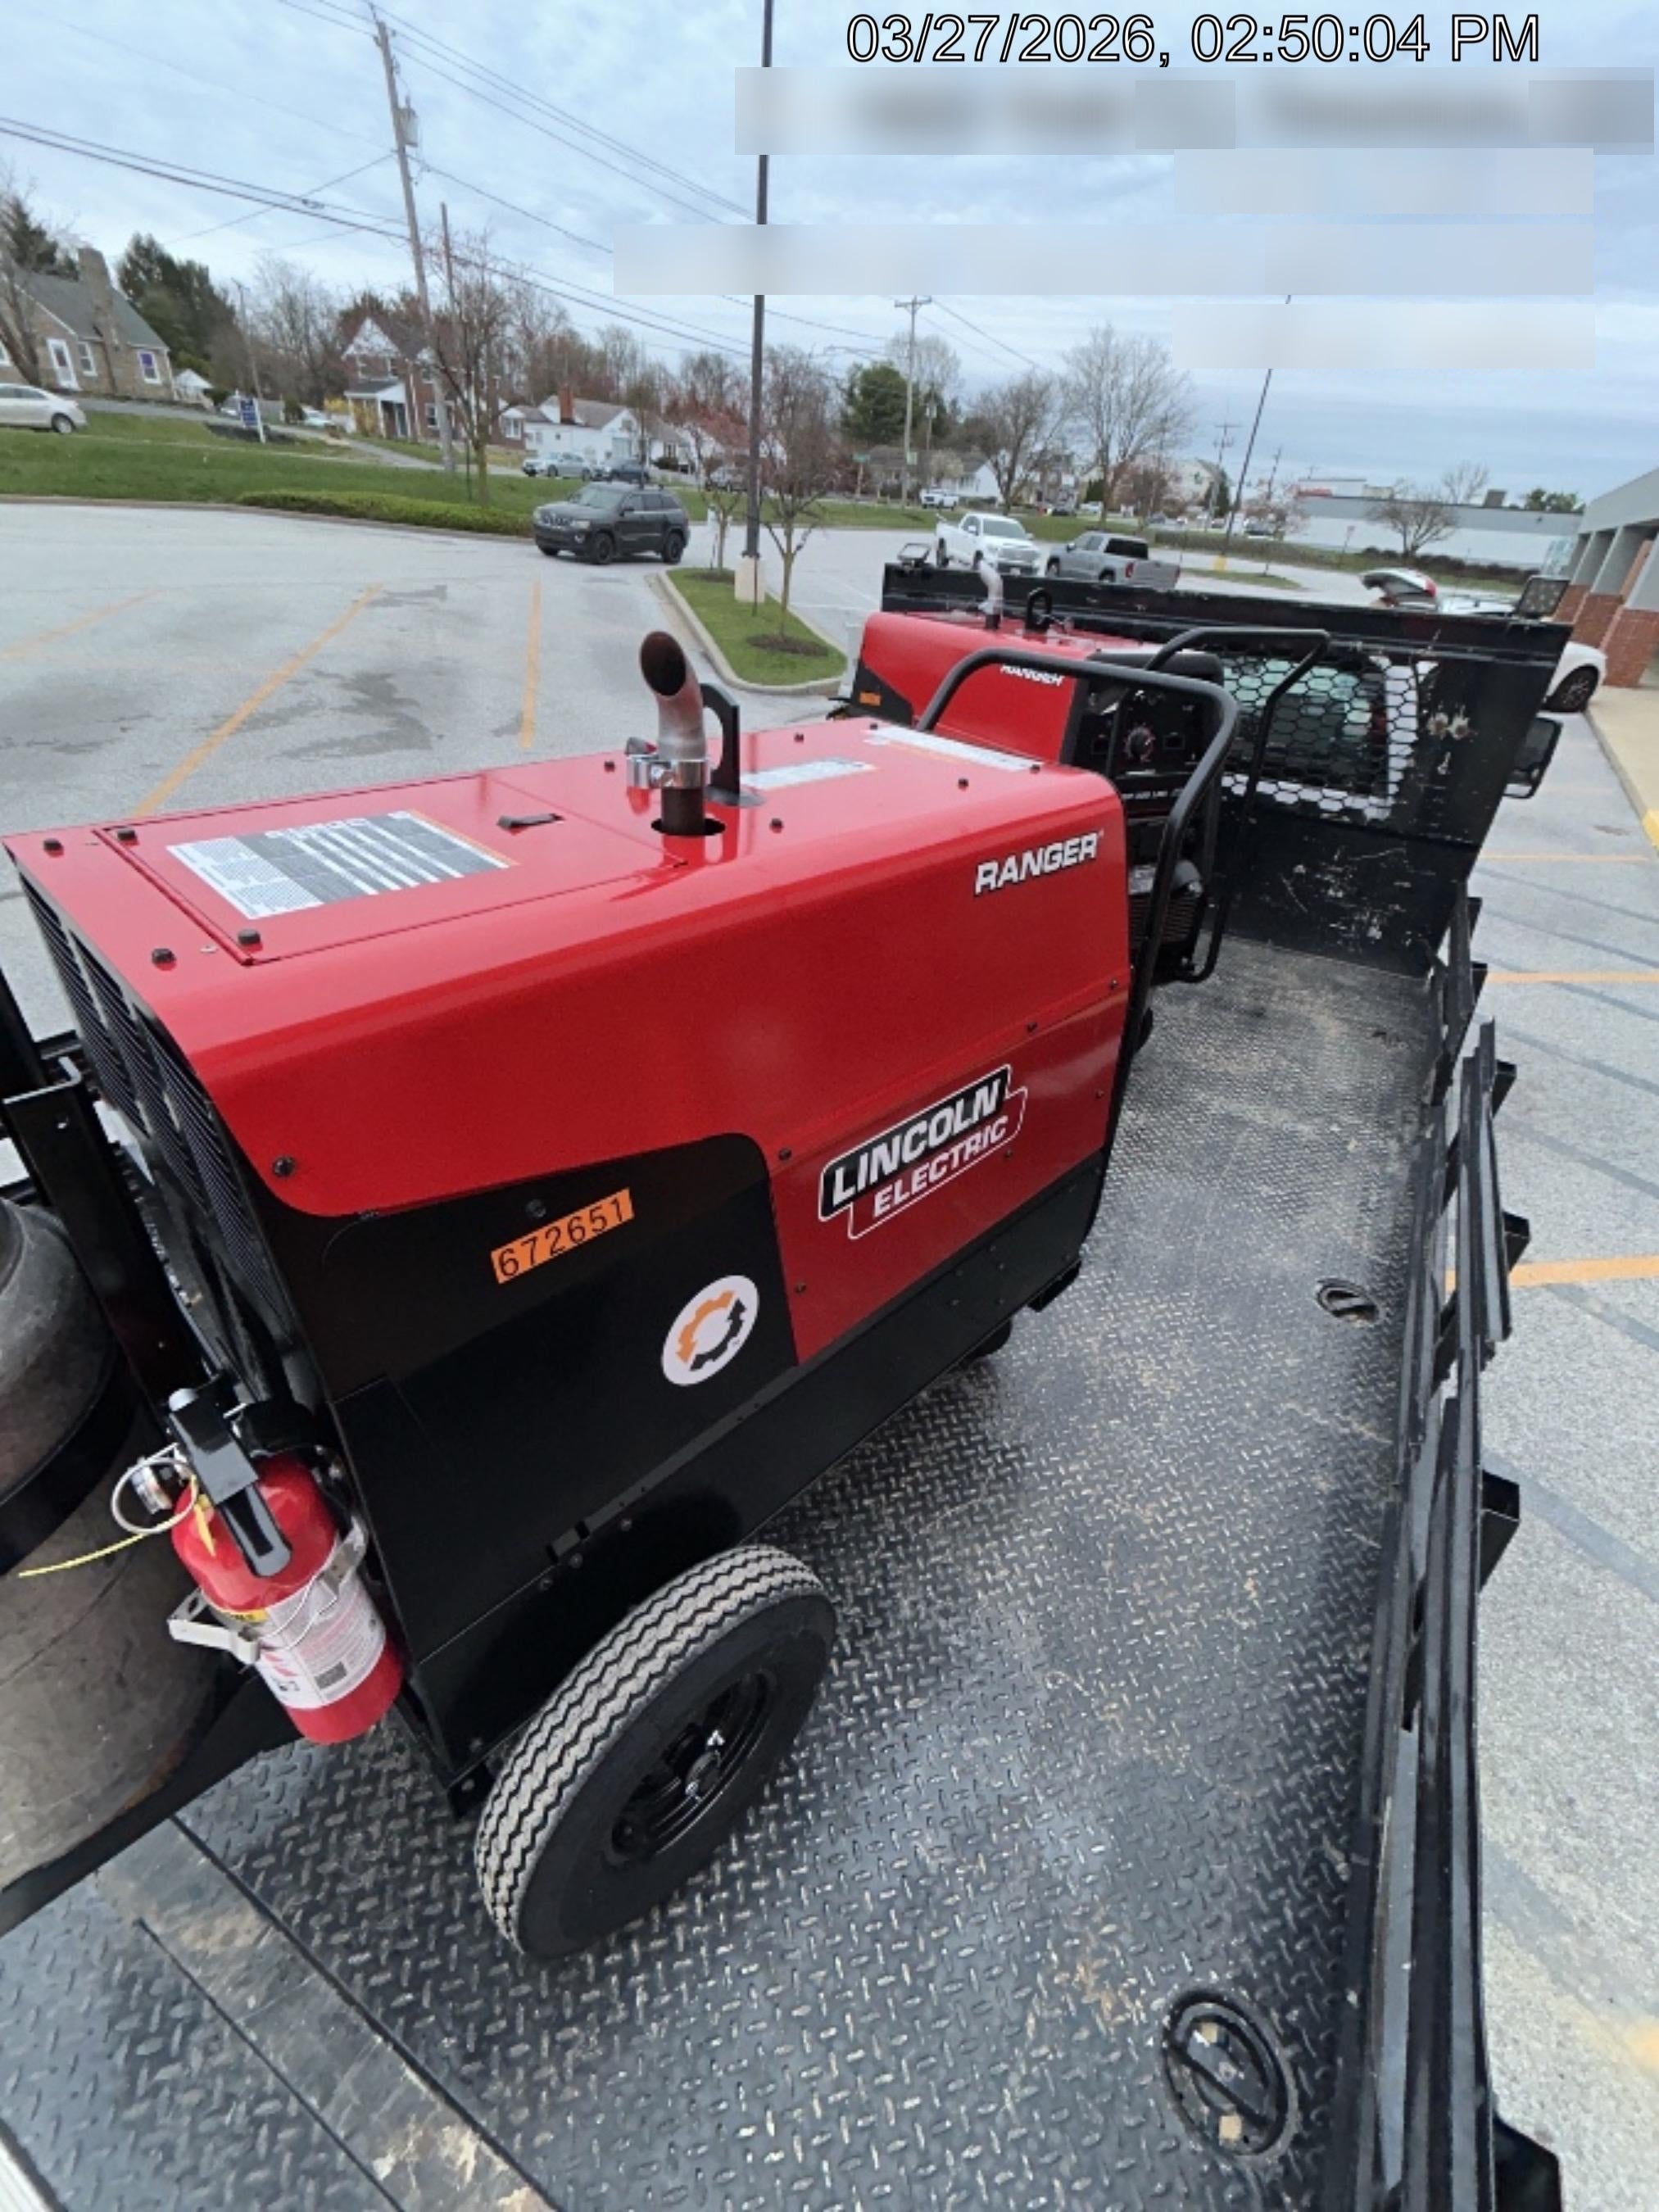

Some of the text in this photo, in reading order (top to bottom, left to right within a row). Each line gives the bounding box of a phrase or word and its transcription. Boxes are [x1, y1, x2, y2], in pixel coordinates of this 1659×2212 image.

[974, 832, 1098, 895] RANGER
[832, 1078, 1001, 1207] LINCOLN
[873, 1115, 1009, 1217] ELECTRIC
[498, 1199, 623, 1276] 672651
